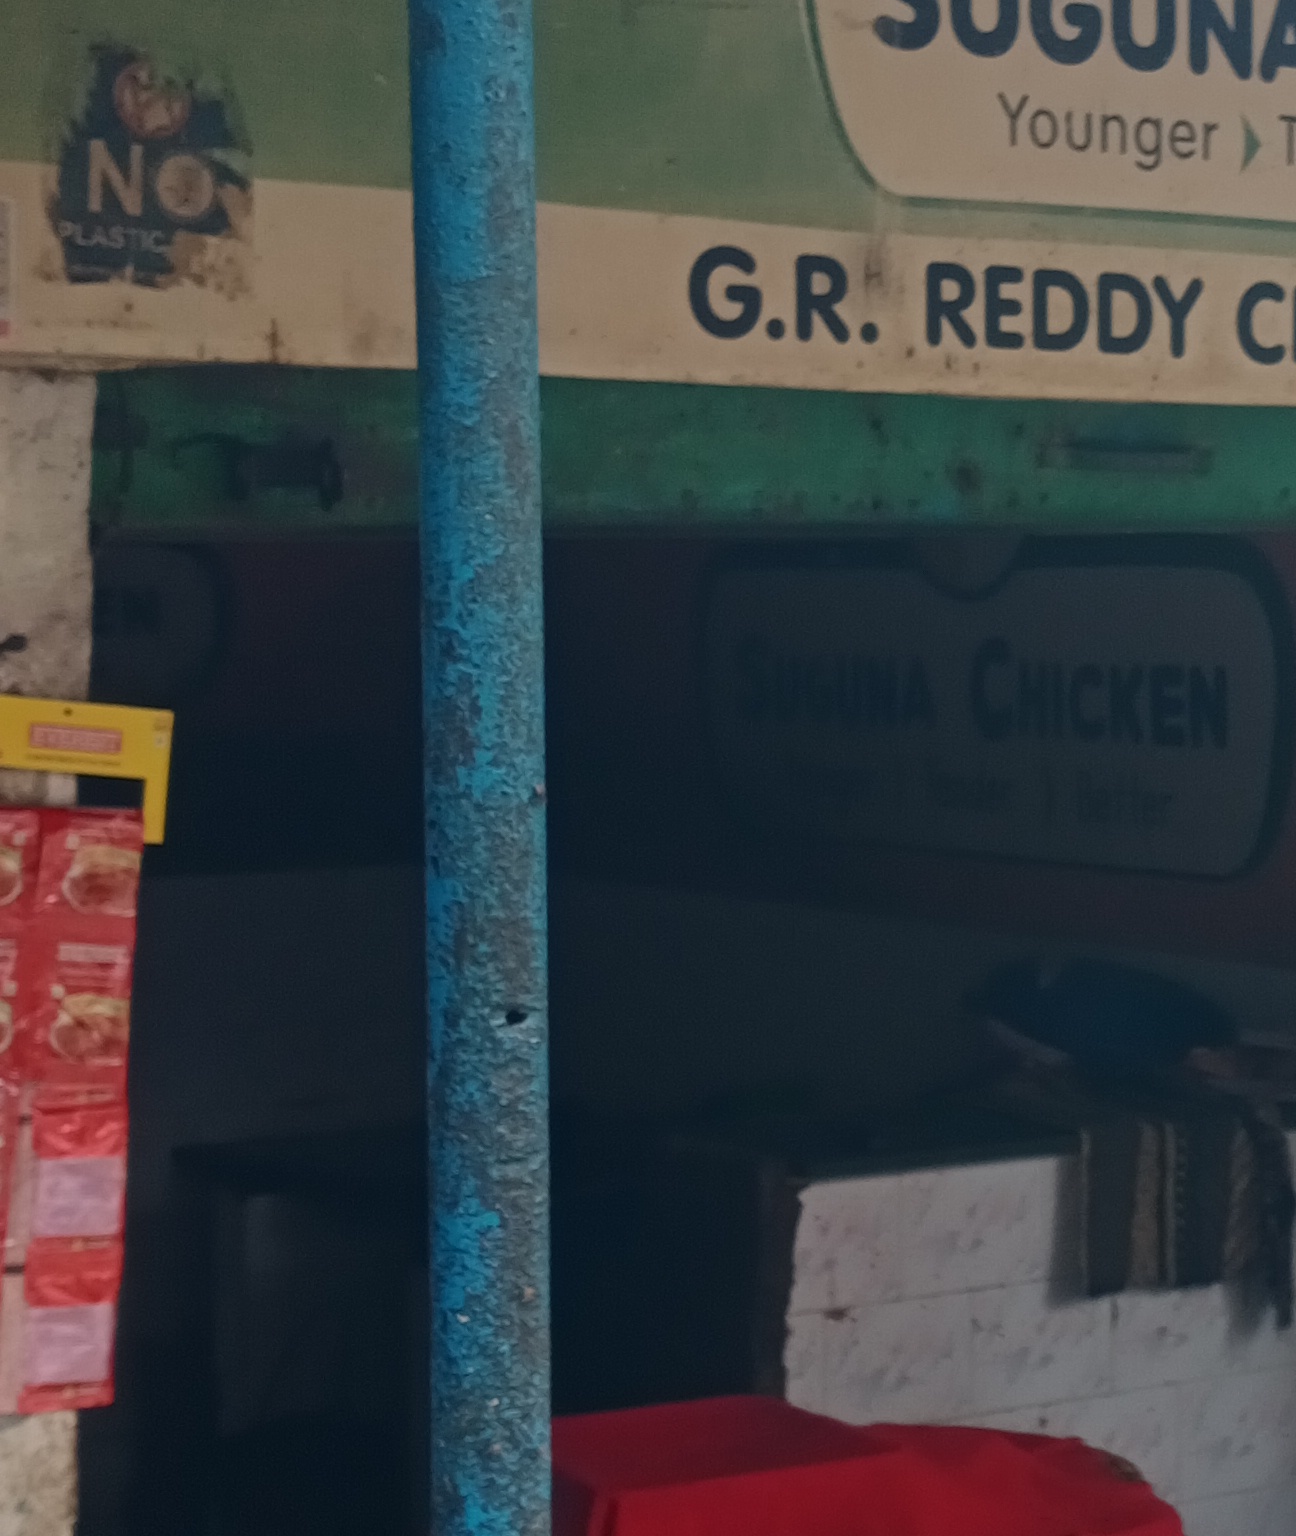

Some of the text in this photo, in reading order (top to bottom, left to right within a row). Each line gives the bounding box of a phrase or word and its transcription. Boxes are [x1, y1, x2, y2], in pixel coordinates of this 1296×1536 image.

[88, 139, 215, 218] NO
[998, 91, 1219, 171] Younger
[687, 246, 879, 345] G.R.
[923, 261, 1203, 358] REDDY
[970, 636, 1229, 750] CHICKEN
